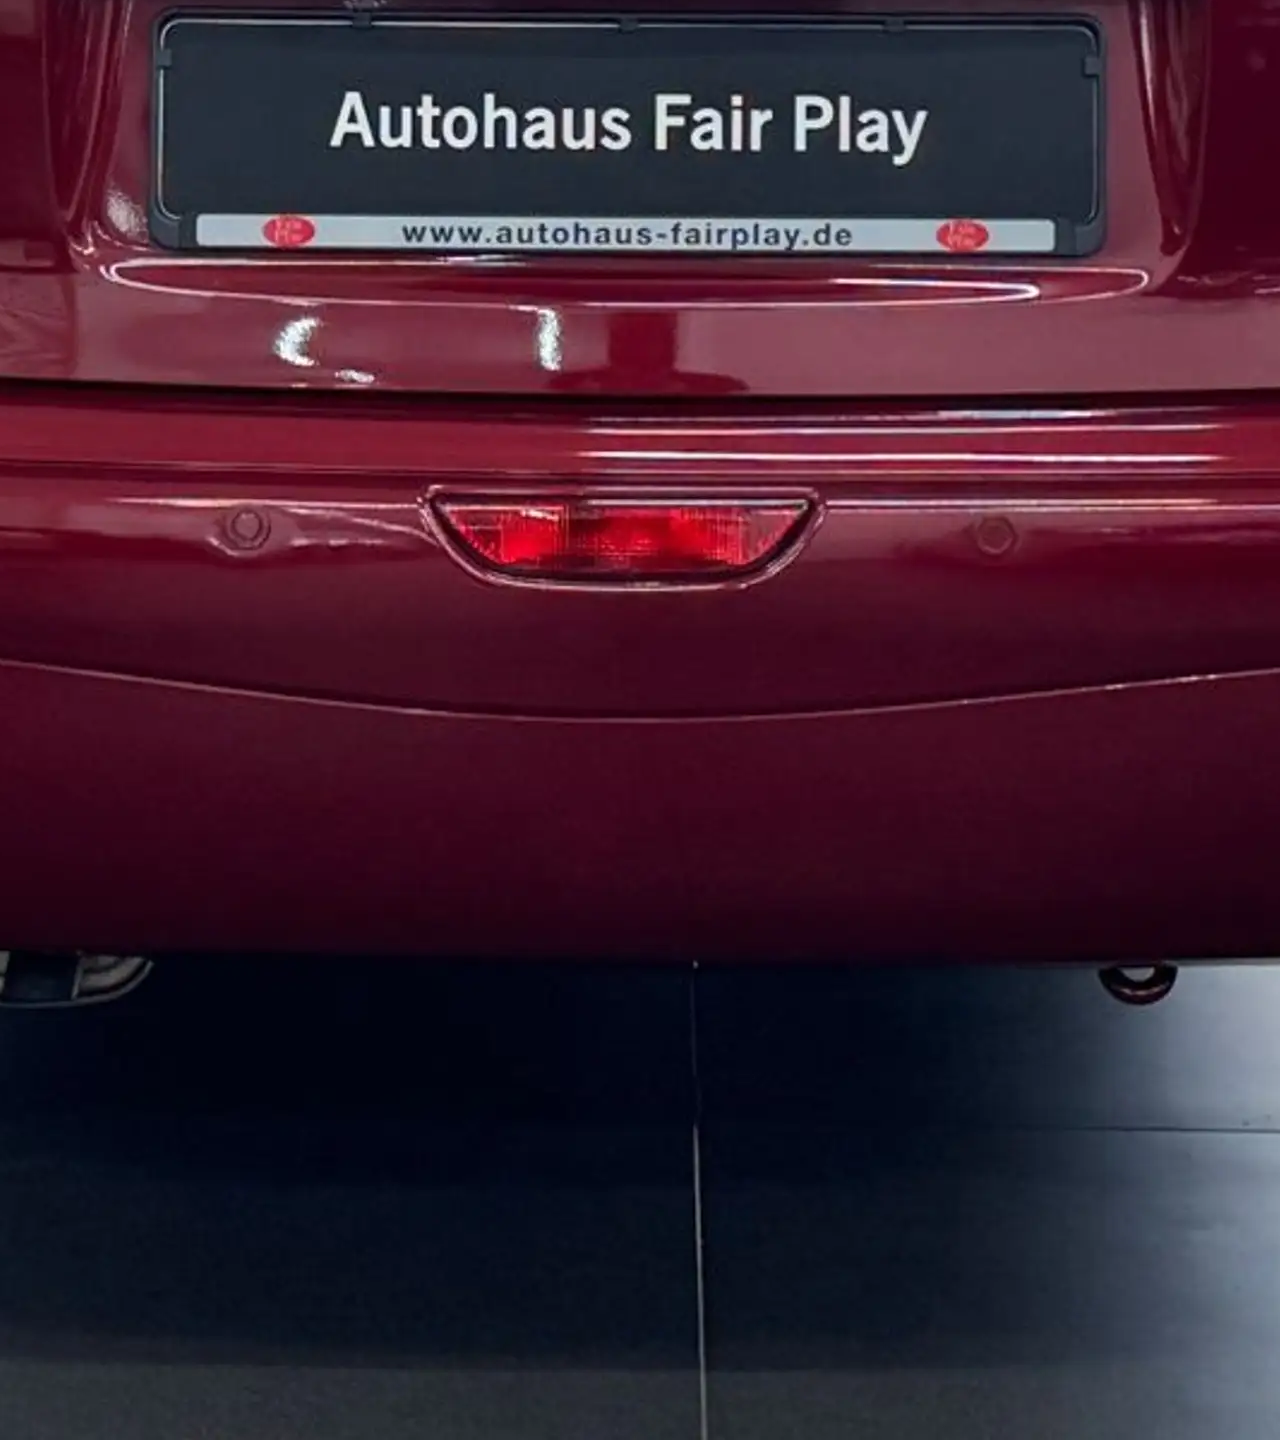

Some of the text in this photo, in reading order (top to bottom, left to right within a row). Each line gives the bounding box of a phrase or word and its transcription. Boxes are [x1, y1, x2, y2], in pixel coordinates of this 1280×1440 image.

[329, 90, 929, 167] Autohaus Fair Play
[401, 220, 853, 251] www.autohaus-fairplay.de
